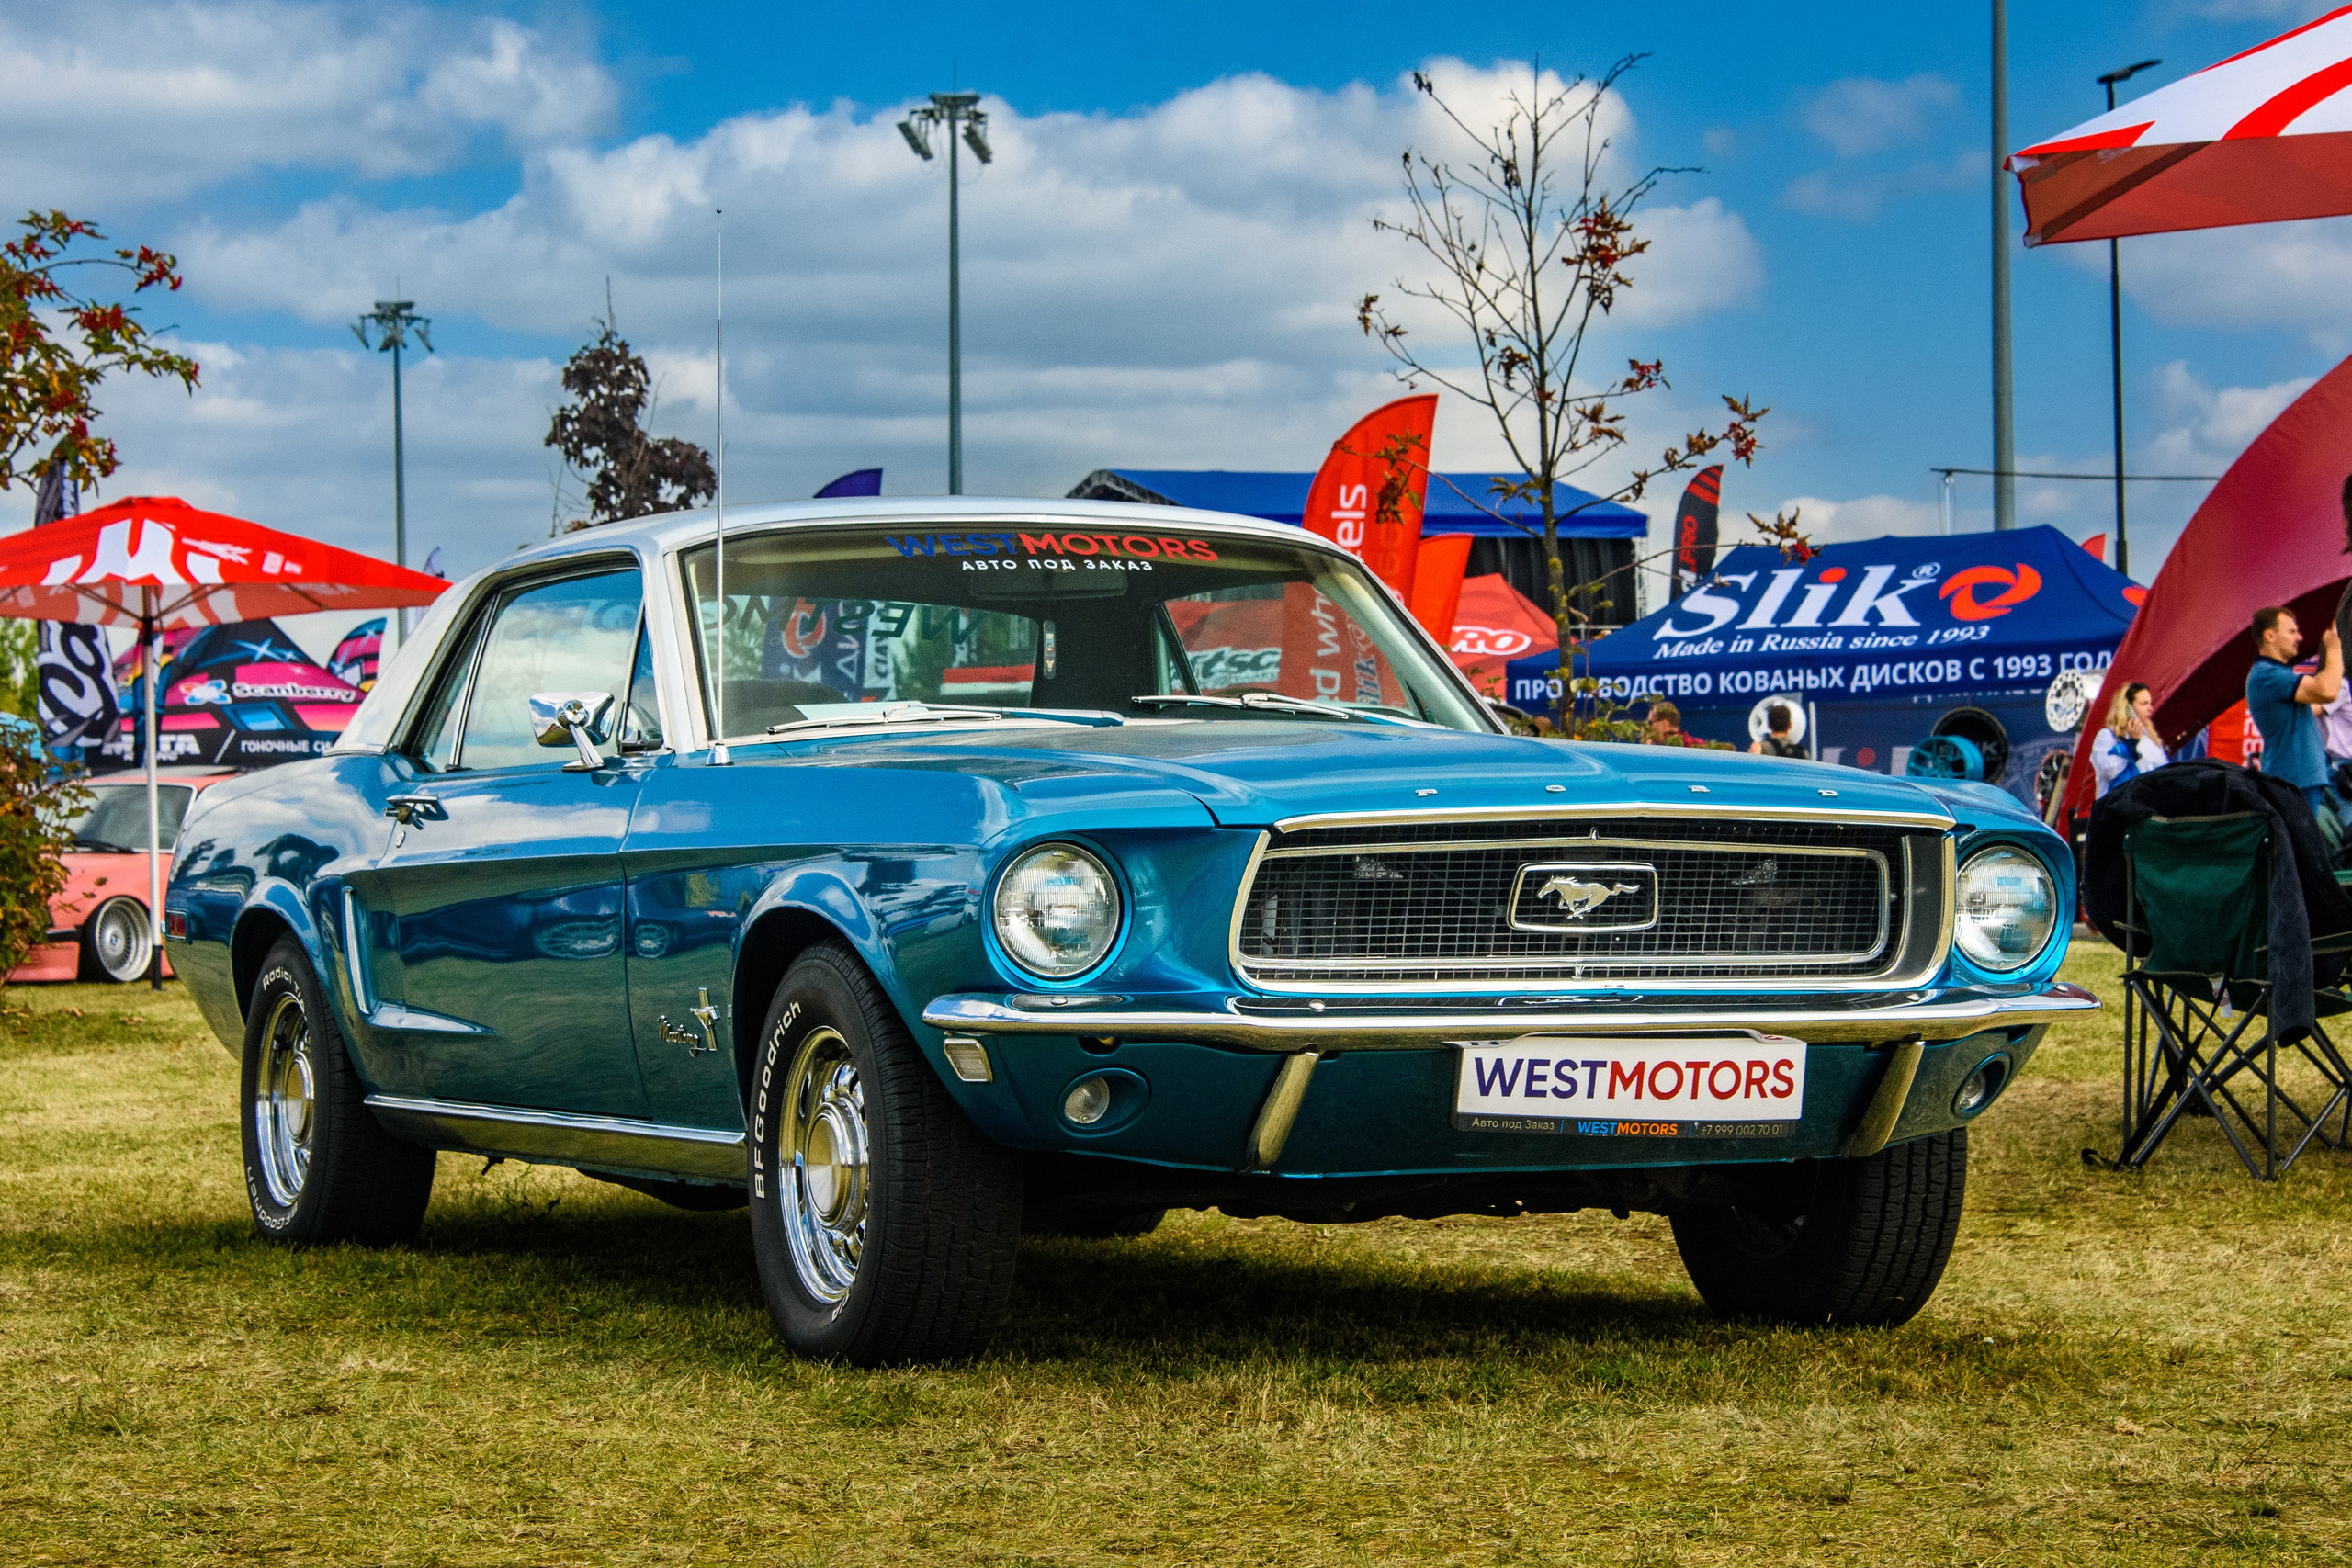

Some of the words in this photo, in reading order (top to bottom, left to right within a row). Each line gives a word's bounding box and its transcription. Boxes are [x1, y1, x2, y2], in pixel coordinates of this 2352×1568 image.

[885, 533, 1218, 562] WESTMOTORS
[962, 559, 1018, 570] АВТО
[1027, 559, 1076, 571] ПОД
[1086, 559, 1153, 571] ЗАКАЗ
[1653, 564, 1937, 640] Slik
[1654, 637, 1724, 660] Made
[1729, 635, 1754, 653] in
[1759, 632, 1843, 652] Russia
[1849, 632, 1918, 649] since
[1926, 625, 1991, 645] 1993
[1515, 672, 1713, 702] ПРОВОДСТВО
[1720, 665, 1845, 694] КОВАНЫХ
[1850, 659, 1962, 693] ДИСКОВ
[1969, 657, 1985, 680] С
[1993, 654, 2052, 680] 1993
[2060, 650, 2113, 674] ГОД
[232, 682, 356, 702] Scanberry
[240, 739, 310, 753] ГОНОЧНЫЕ
[263, 965, 292, 991] Radial
[1474, 1056, 1796, 1100] WESTMOTORS
[754, 1001, 801, 1199] BFGoodrich
[1471, 1117, 1499, 1129] Авто
[1501, 1119, 1522, 1132] под
[1524, 1119, 1555, 1131] Заказ
[1577, 1121, 1679, 1136] WESTMOTORS
[1700, 1123, 1713, 1136] +7
[1713, 1124, 1734, 1136] 999
[1735, 1124, 1757, 1136] 002
[1758, 1123, 1770, 1136] 70
[1771, 1123, 1783, 1135] 01
